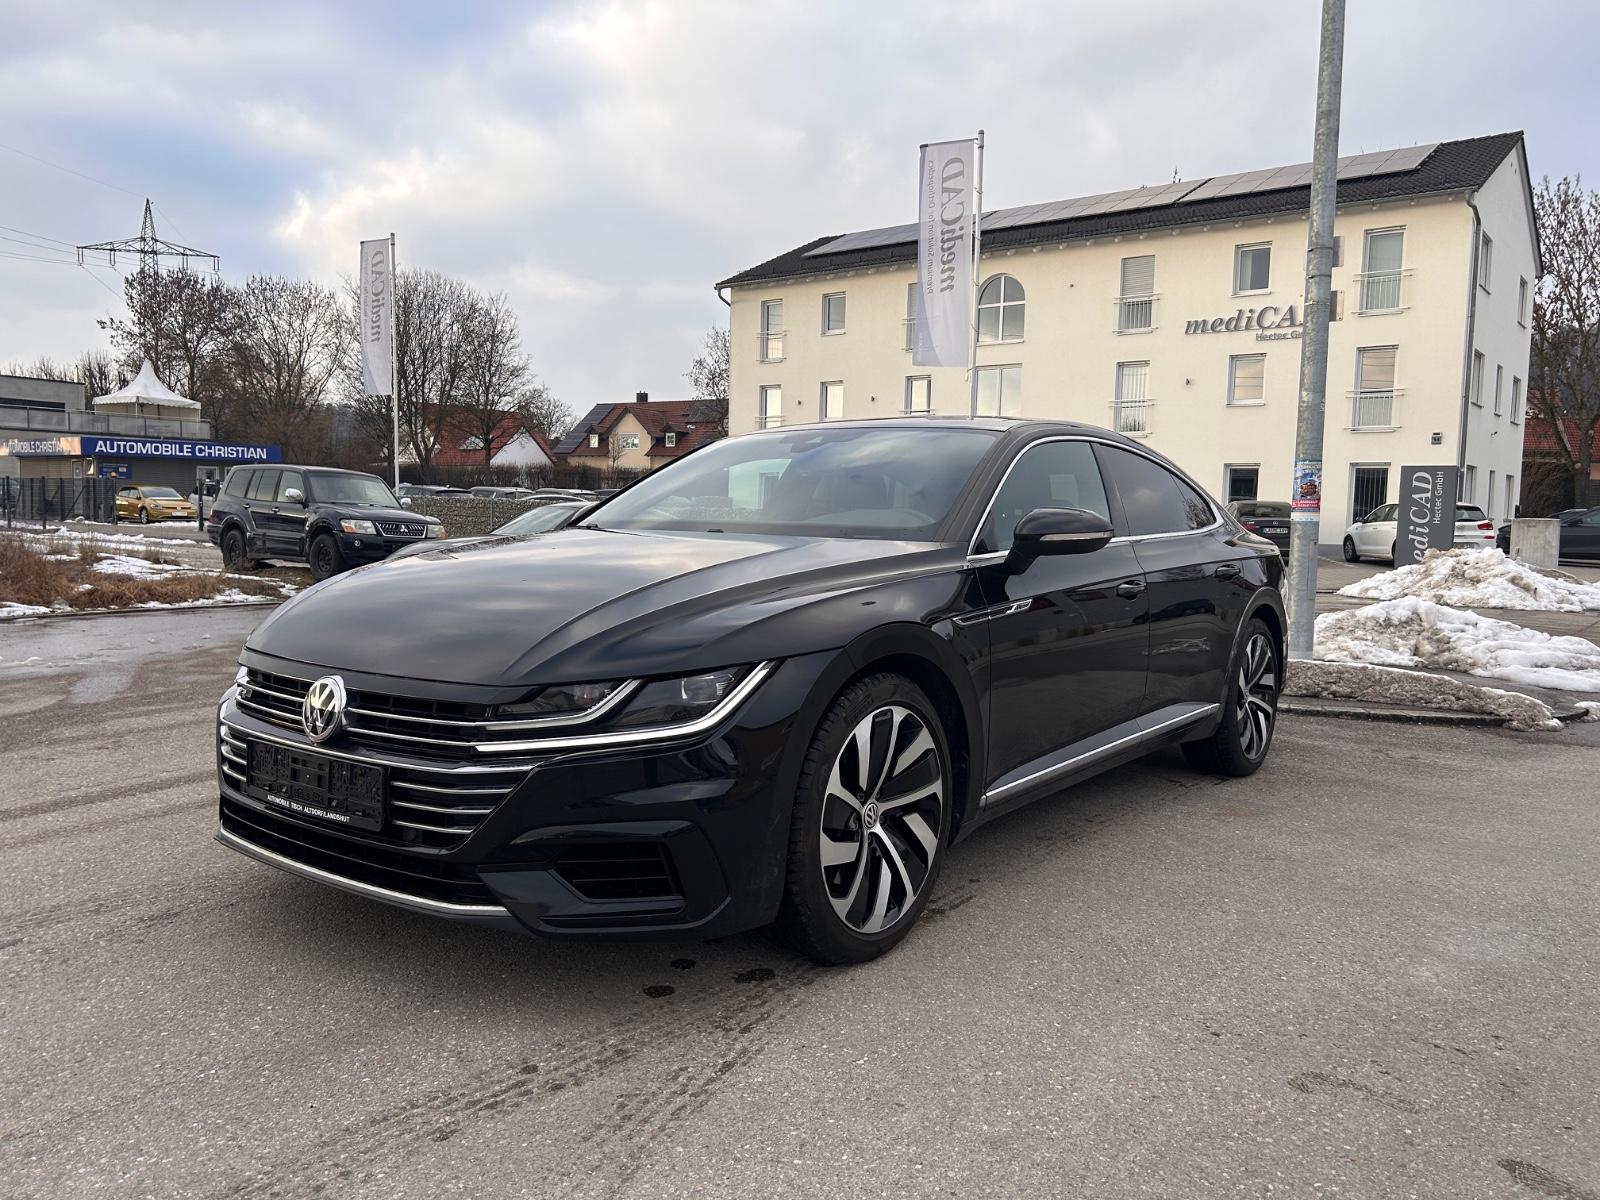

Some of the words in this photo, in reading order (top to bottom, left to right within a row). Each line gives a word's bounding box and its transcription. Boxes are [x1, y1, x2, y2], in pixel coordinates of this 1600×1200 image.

[1185, 304, 1304, 335] mediCA
[95, 440, 192, 457] AUTOMOBILE
[195, 445, 267, 460] CHRISTIAN
[1435, 471, 1444, 496] GmbH
[1408, 471, 1432, 562] ediCAD
[1433, 499, 1442, 524] Hectec
[267, 794, 290, 807] AUTOMOBILE
[290, 802, 303, 811] TISCH
